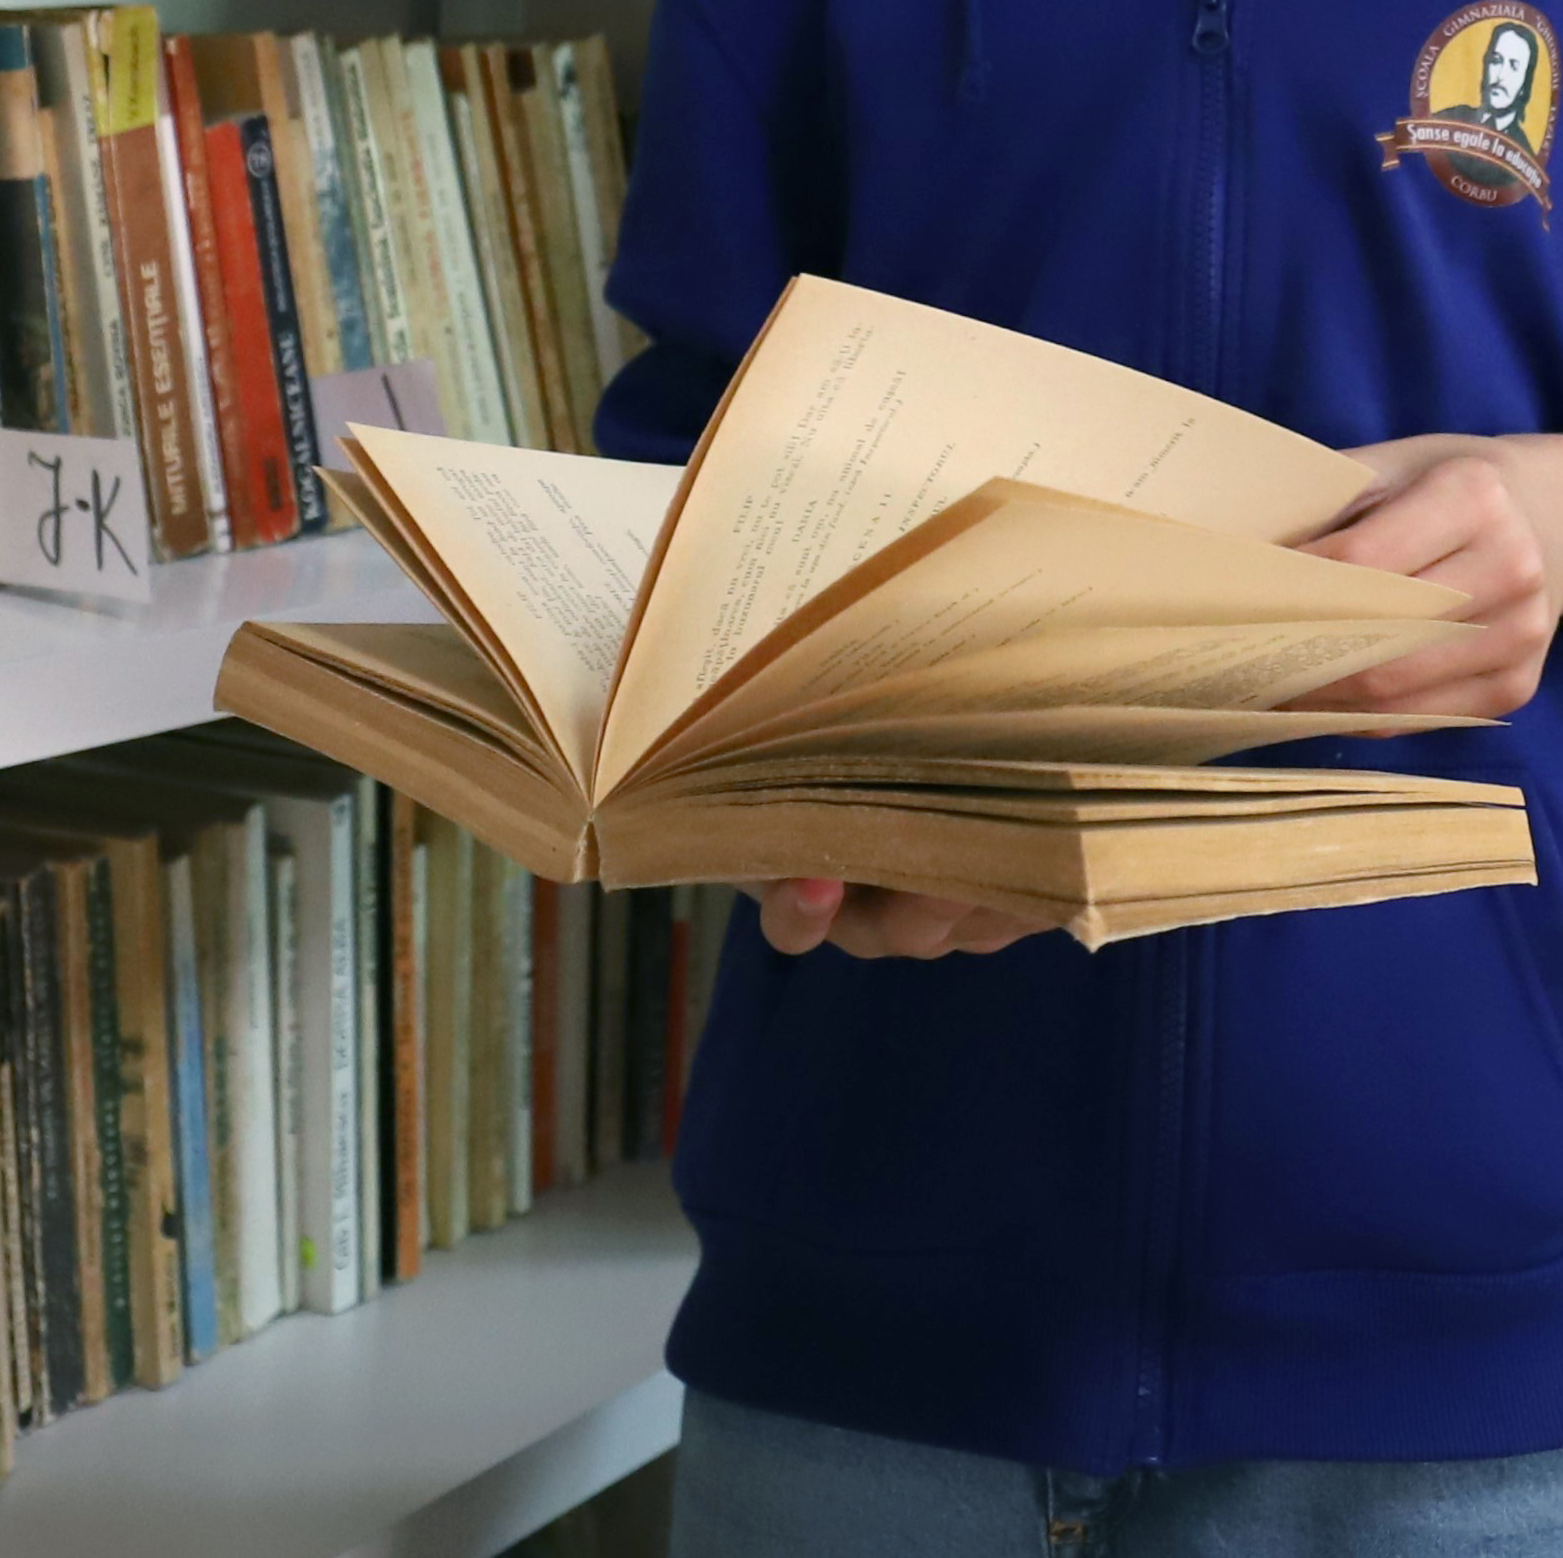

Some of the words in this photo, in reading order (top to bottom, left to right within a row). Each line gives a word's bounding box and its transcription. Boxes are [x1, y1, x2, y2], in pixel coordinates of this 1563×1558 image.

[1452, 130, 1491, 153] egale
[1491, 140, 1506, 158] la
[1450, 174, 1498, 203] CORBU
